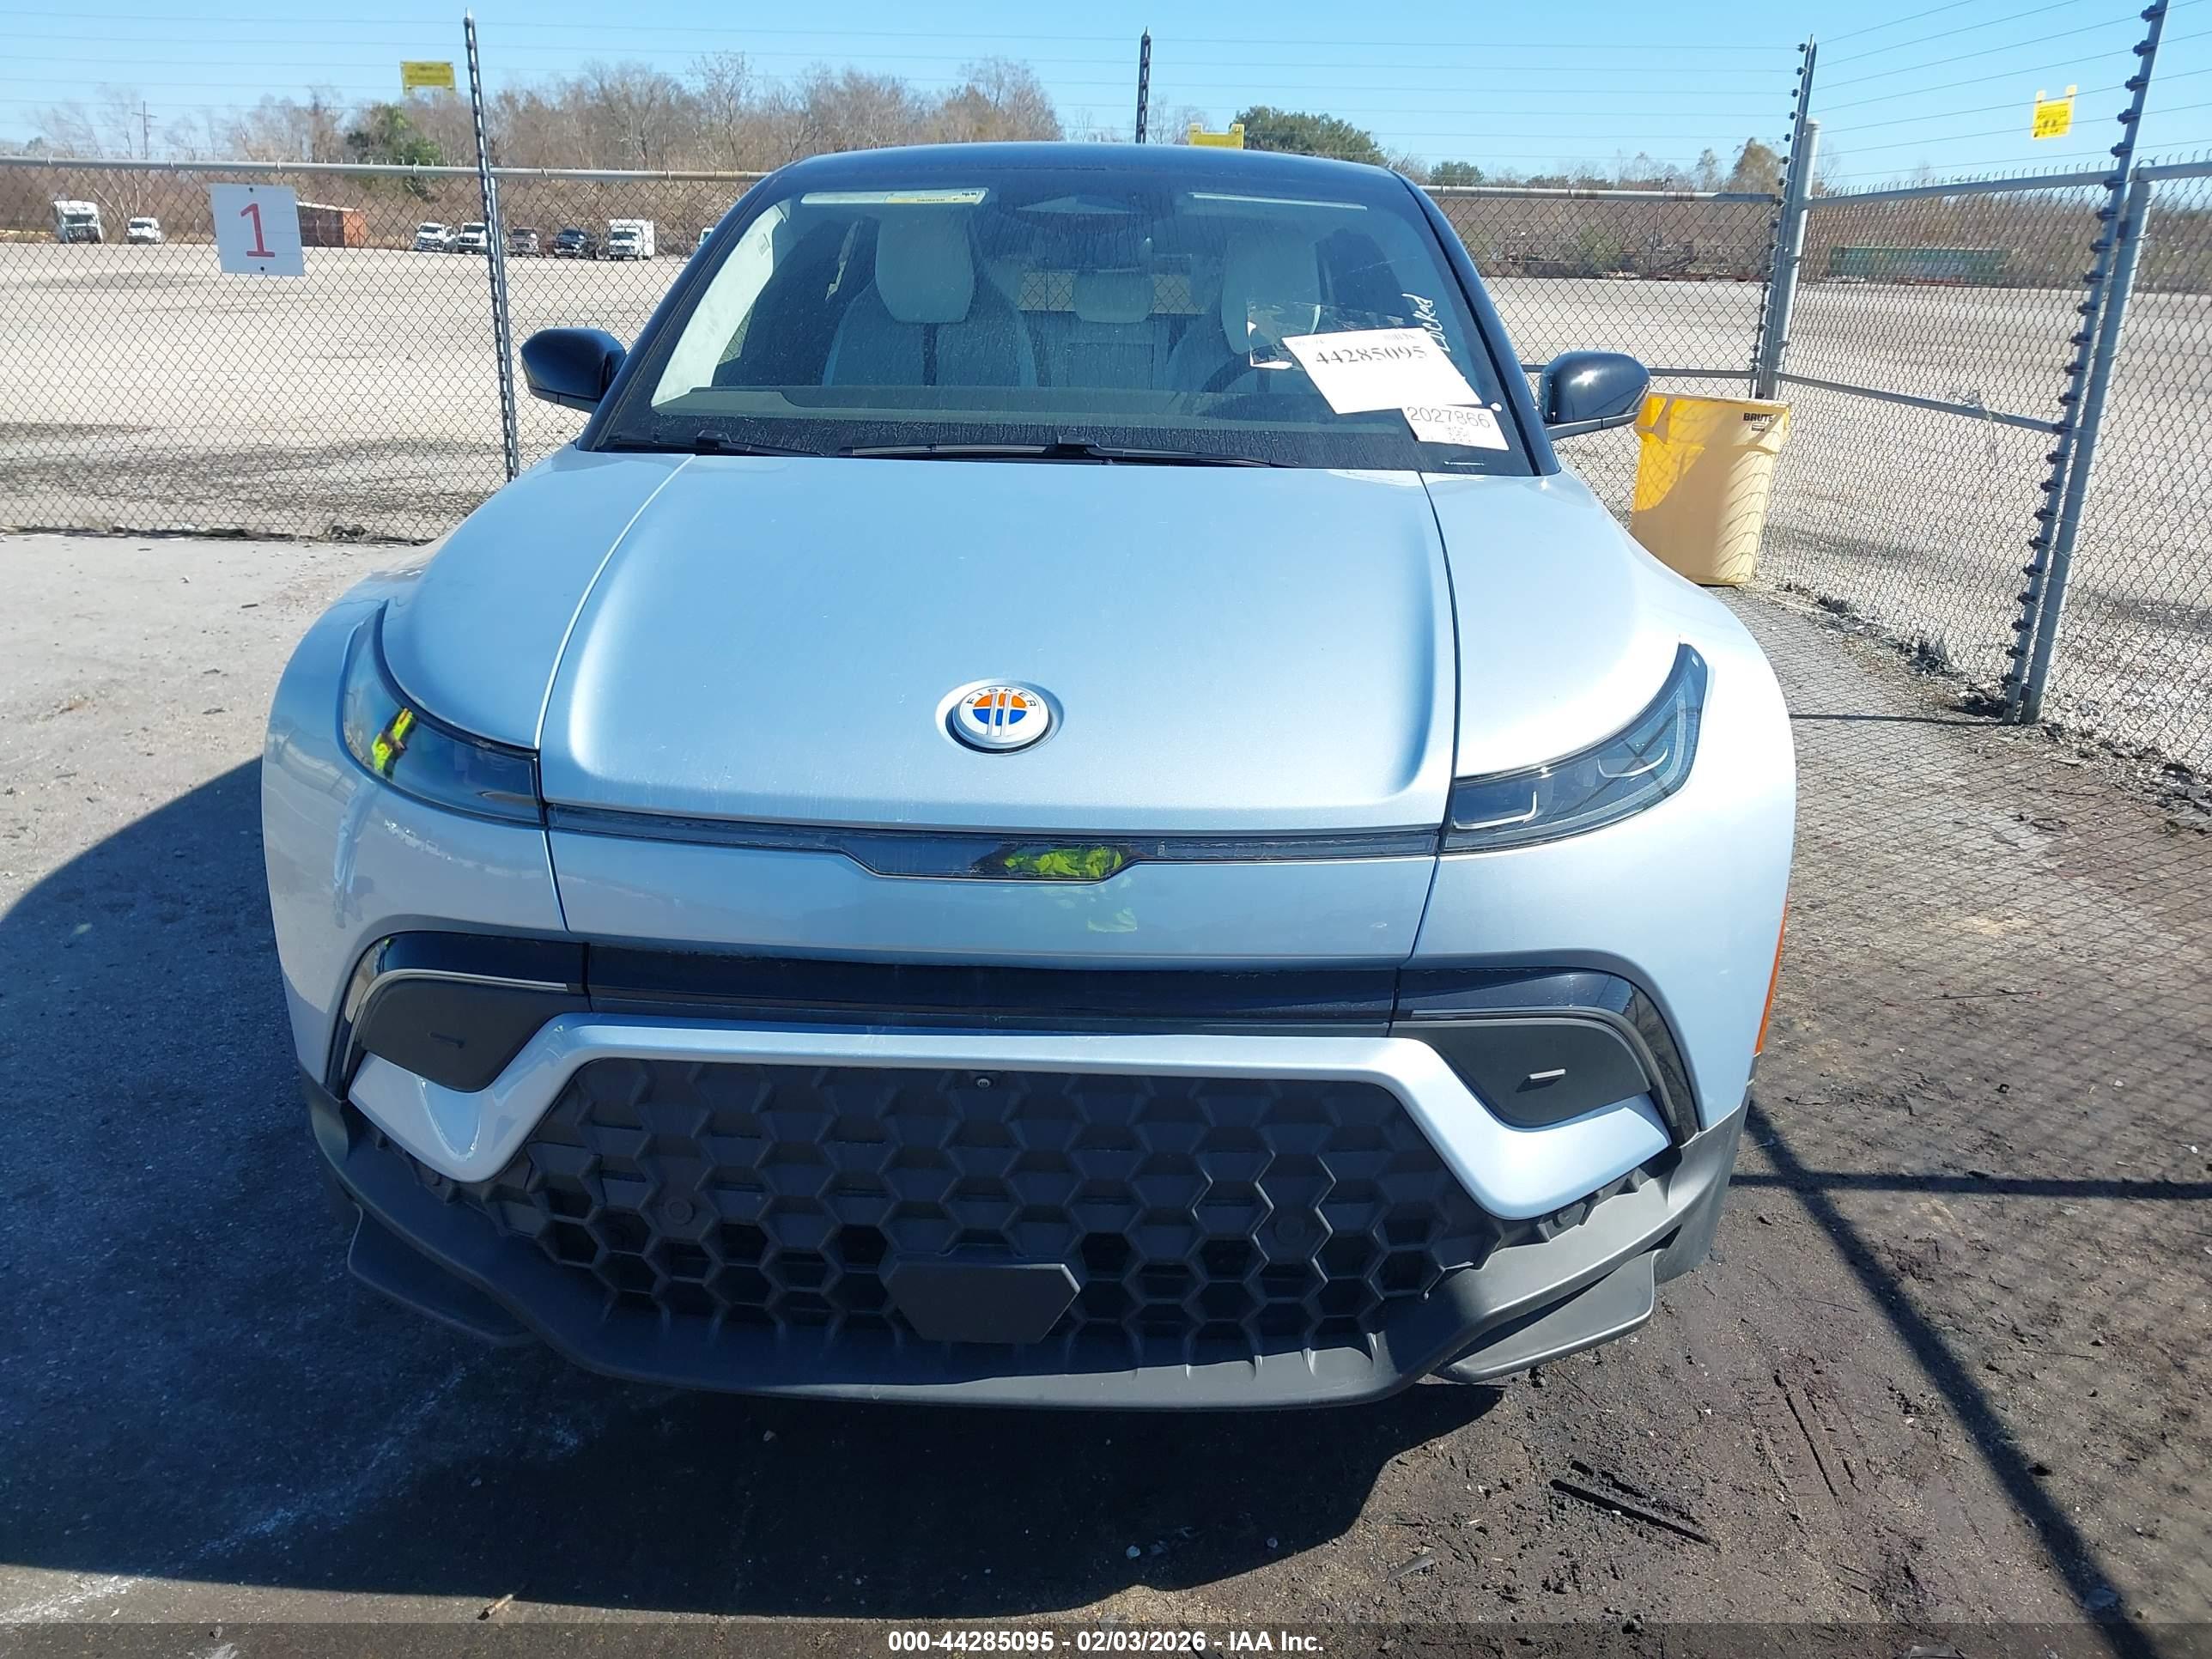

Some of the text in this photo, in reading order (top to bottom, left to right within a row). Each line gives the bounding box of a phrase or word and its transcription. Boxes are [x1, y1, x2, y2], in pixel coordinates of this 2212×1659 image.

[240, 203, 276, 258] 1
[1316, 345, 1427, 364] 44285095
[1407, 406, 1491, 428] 2027866
[967, 687, 1037, 708] FISKER
